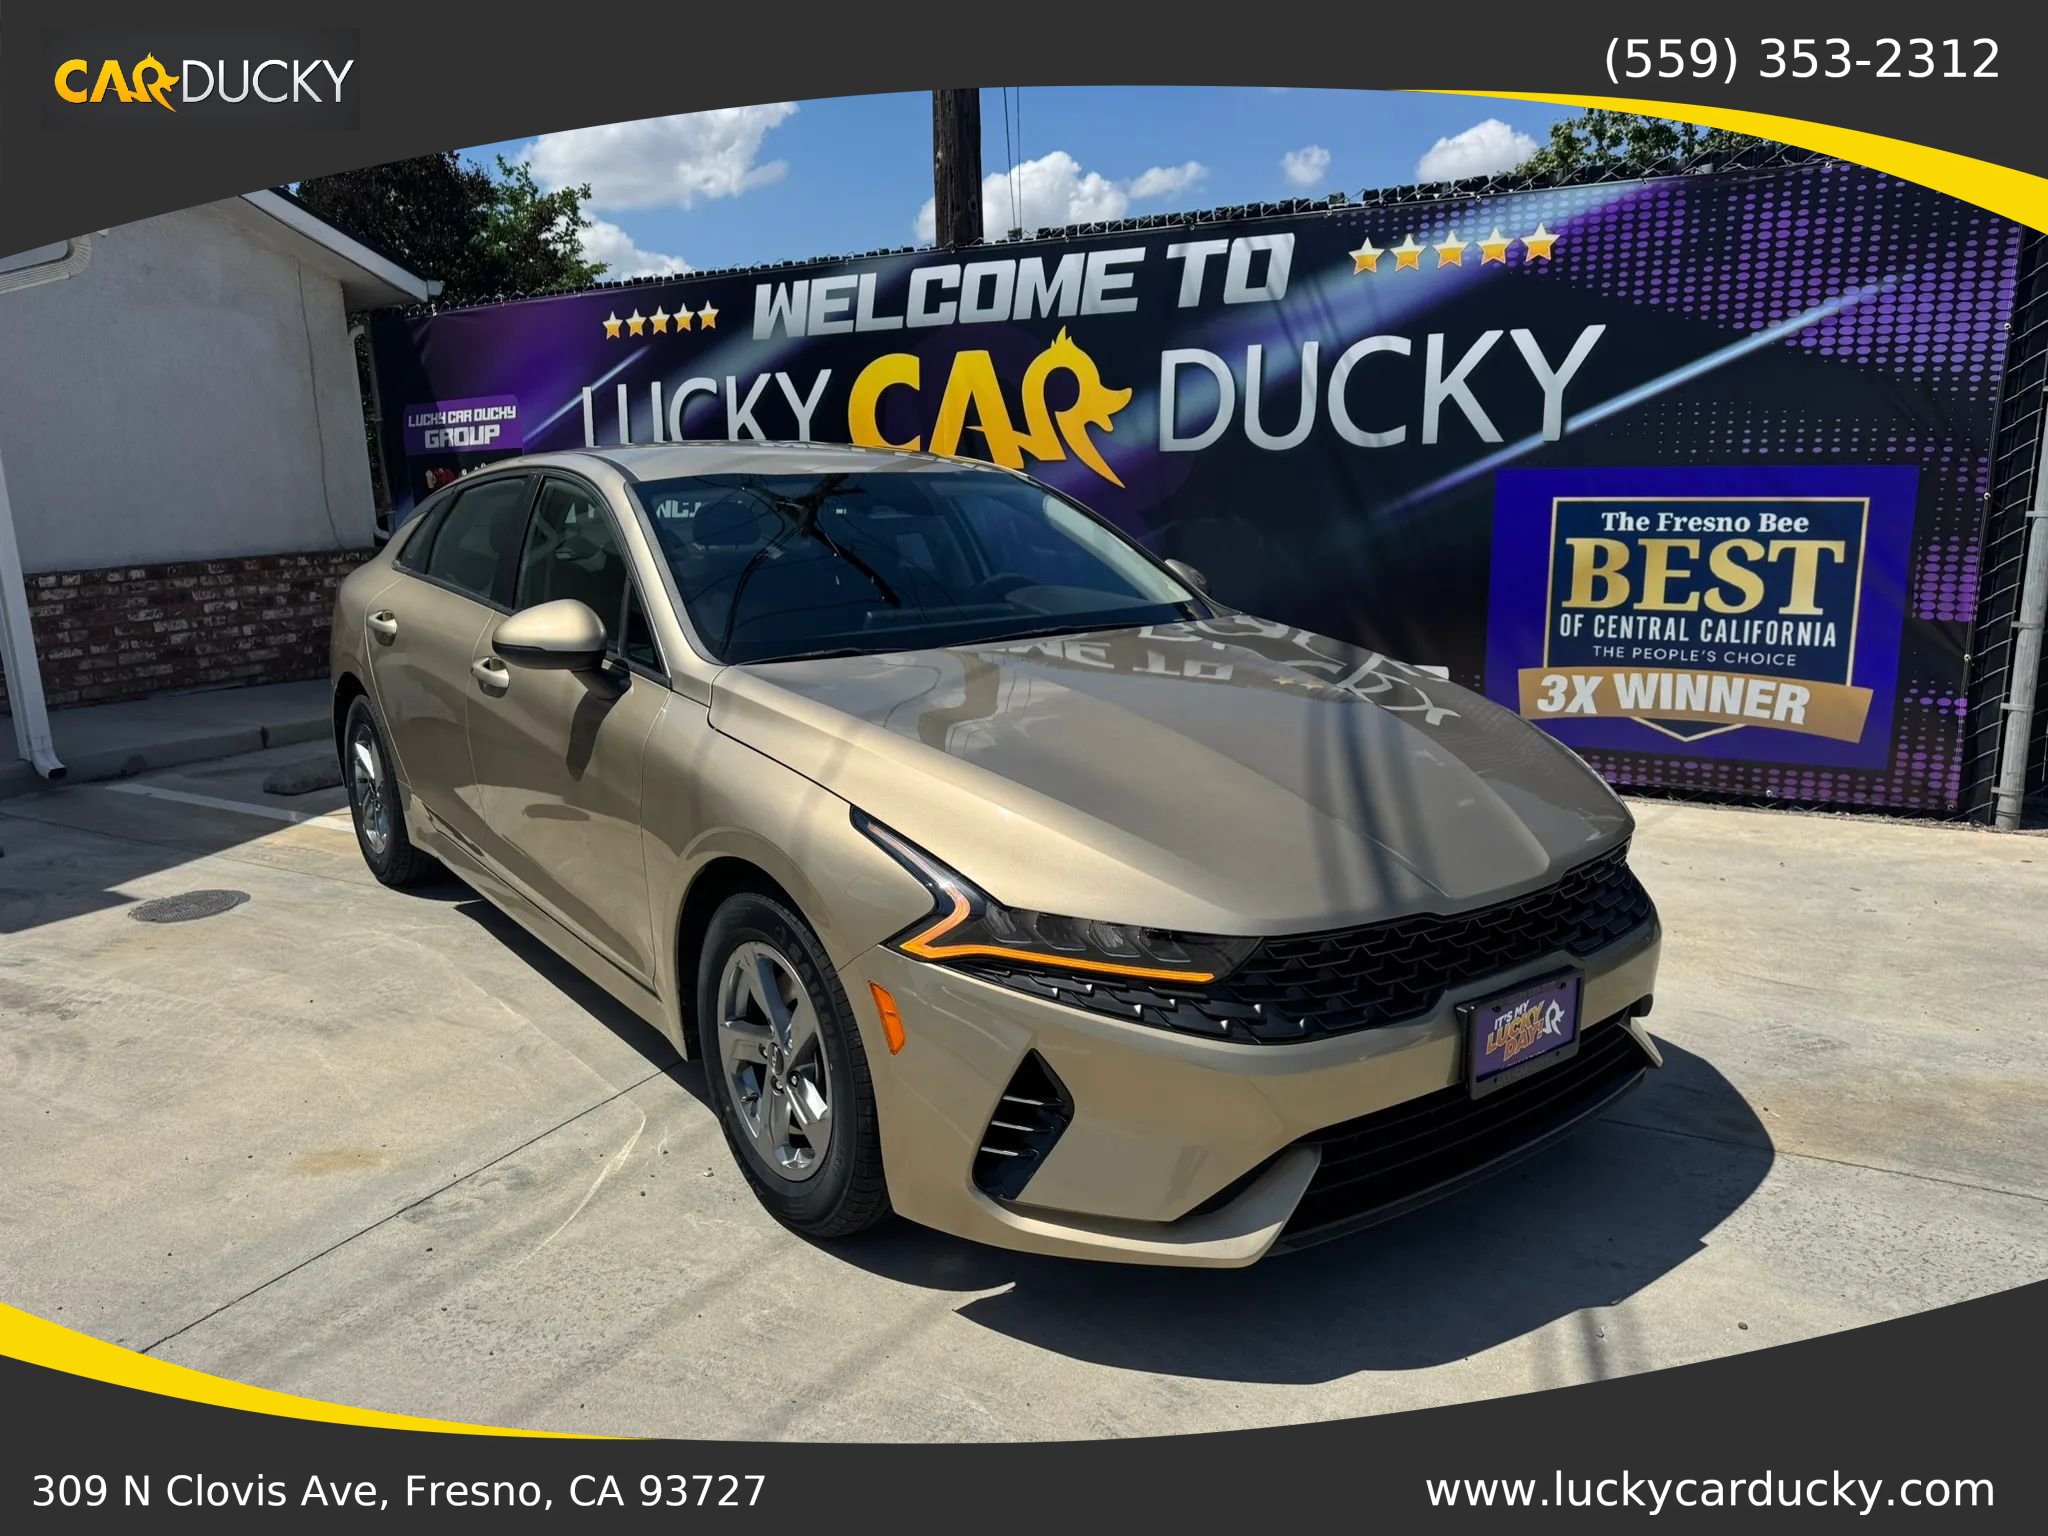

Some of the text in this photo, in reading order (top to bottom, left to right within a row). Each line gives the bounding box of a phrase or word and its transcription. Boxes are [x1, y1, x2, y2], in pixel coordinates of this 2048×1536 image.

[752, 232, 1295, 340] WELCOME TO
[408, 405, 517, 428] LUCKY CAR DUCKY
[582, 324, 1606, 489] LUCKY CAR DUCKY
[424, 424, 500, 449] GROUP
[1602, 512, 1809, 533] The Fresno Bee
[1562, 538, 1846, 615] BEST
[1559, 614, 1837, 647] OF CENTRAL CALIFORNIA
[1593, 646, 1797, 667] THE PEOPLE'S CHOICE
[1536, 673, 1811, 725] 3X WINNER
[1486, 1000, 1545, 1055] LUCKY
[1494, 1000, 1530, 1029] IT'S MY
[1504, 1020, 1544, 1061] DAY!
